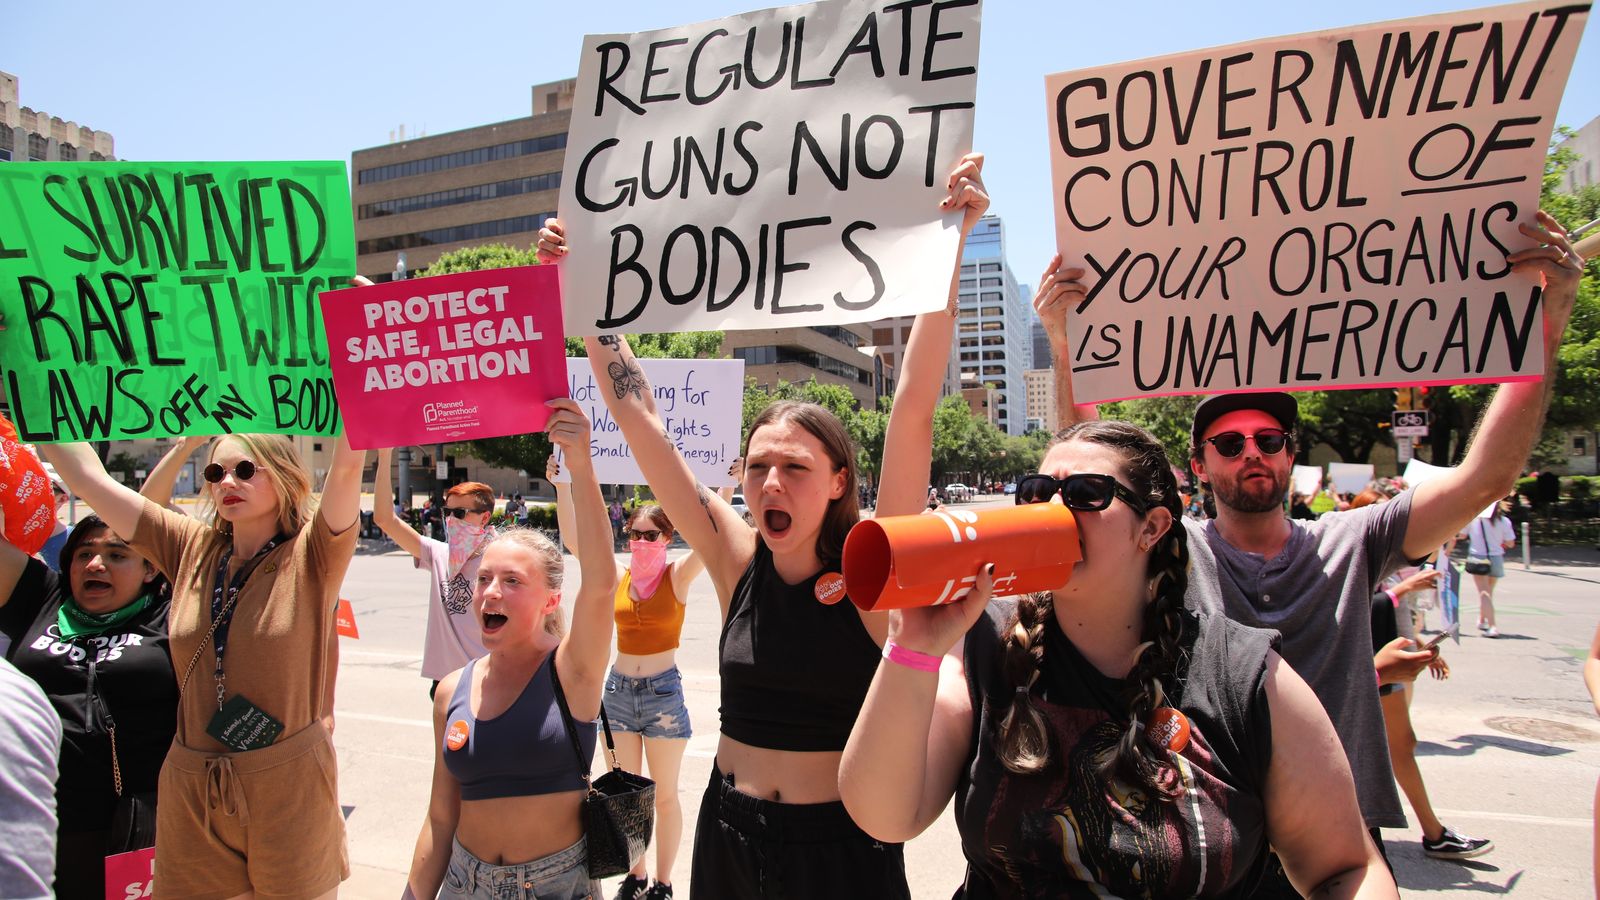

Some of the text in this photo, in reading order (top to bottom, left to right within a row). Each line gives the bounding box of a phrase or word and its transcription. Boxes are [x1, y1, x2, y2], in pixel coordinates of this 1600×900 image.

[595, 0, 979, 116] REGULATE
[1056, 4, 1592, 158] GOVERNMENT
[575, 102, 975, 213] GUNS NOT
[1064, 116, 1541, 232] CONTROL OF
[43, 171, 327, 274] SURVIVED
[596, 216, 886, 330] BODIES
[1077, 201, 1518, 314] YOUR ORGANS
[18, 271, 356, 371] RAPE TWIC
[364, 286, 509, 328] PROTECT
[346, 316, 542, 362] SAFE, LEGAL
[1076, 287, 1542, 391] IS UNAMERICAN
[364, 349, 530, 392] ABORTION
[681, 370, 711, 406] for
[8, 366, 154, 442] LAWS
[160, 373, 209, 435] OFF
[211, 384, 257, 434] MY
[436, 400, 464, 409] Planned
[438, 406, 477, 416] Parenthood
[666, 417, 711, 440] rights
[30, 635, 125, 664] BODES
[237, 716, 270, 750] Vaccinated
[1161, 723, 1181, 746] ODIES
[1163, 715, 1180, 731] OUR
